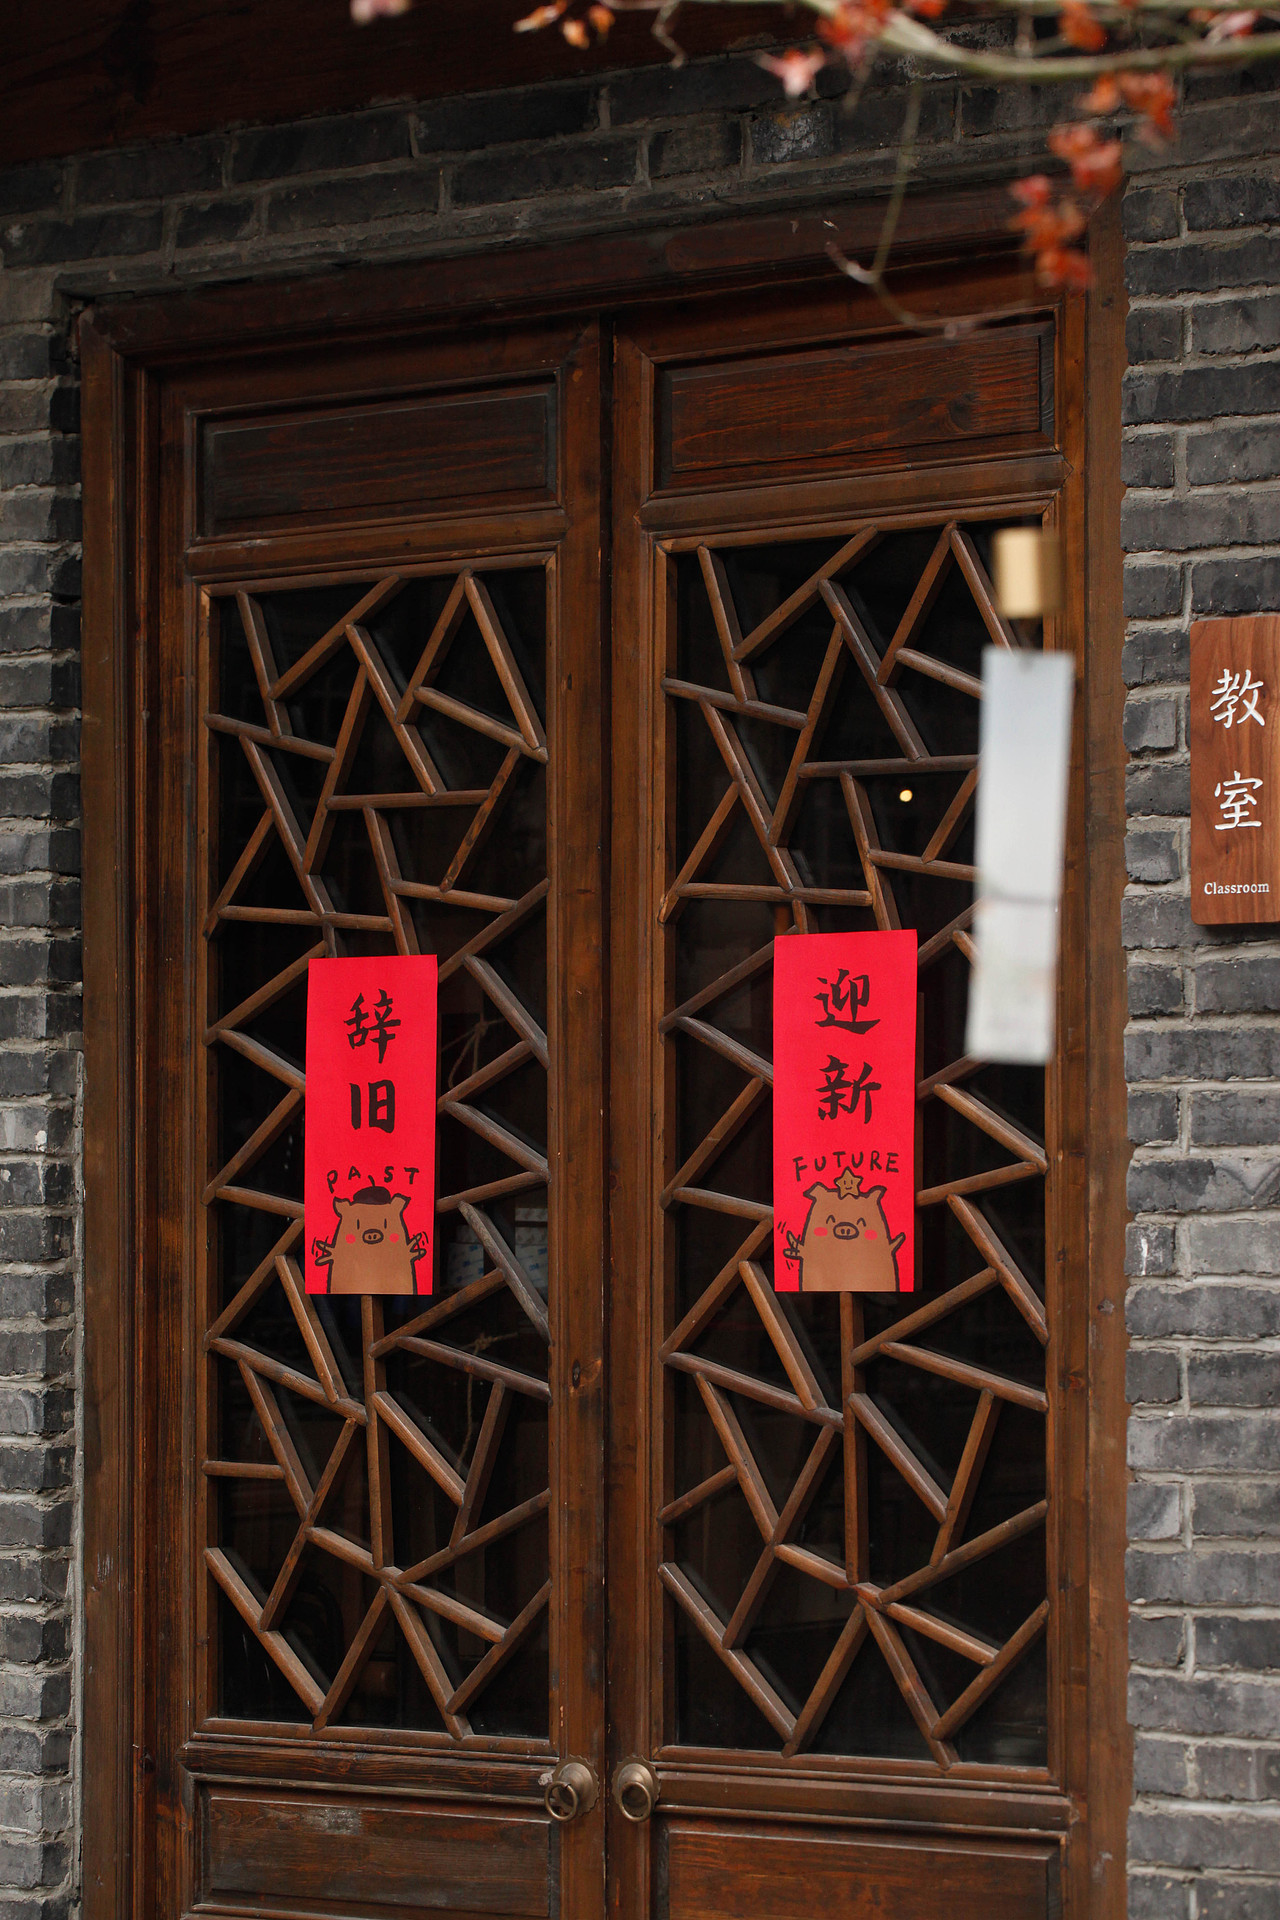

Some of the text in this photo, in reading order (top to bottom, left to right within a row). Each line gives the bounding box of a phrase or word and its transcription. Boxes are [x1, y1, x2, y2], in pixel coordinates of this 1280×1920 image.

[1209, 668, 1266, 831] 教室
[1203, 881, 1270, 895] Classroom
[343, 988, 402, 1134] 辞旧
[813, 968, 882, 1125] 迎新
[326, 1165, 420, 1194] PAST
[792, 1150, 899, 1182] FUTURE
